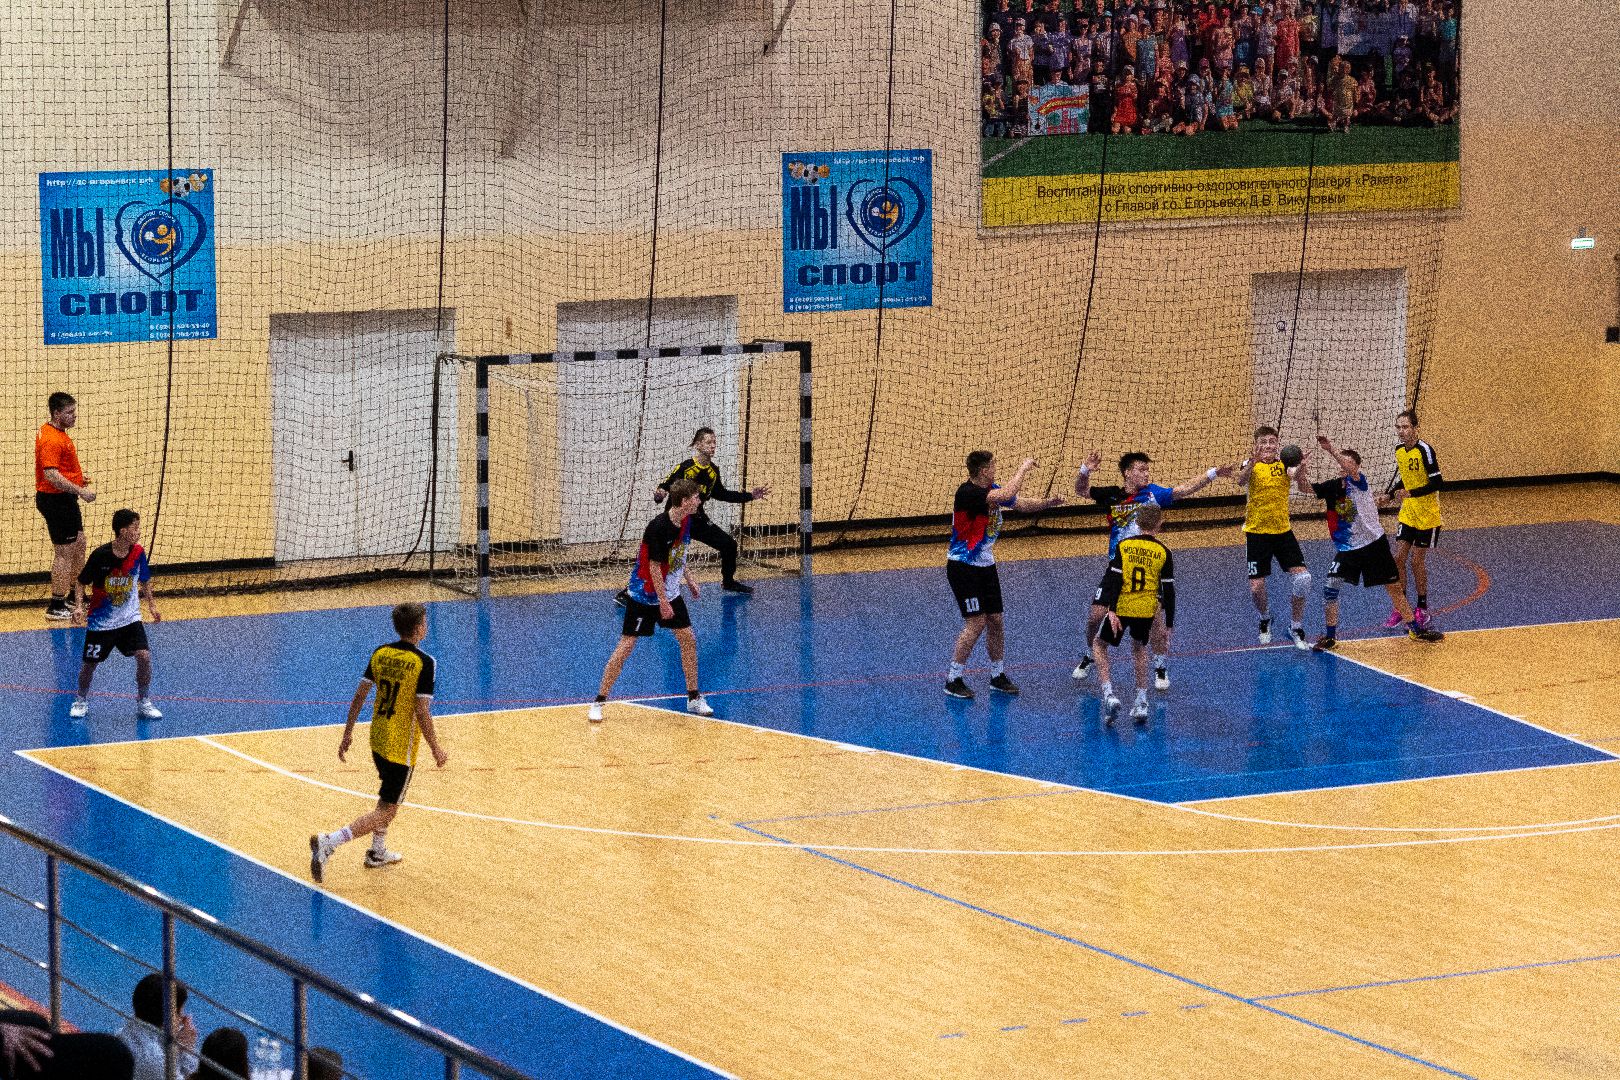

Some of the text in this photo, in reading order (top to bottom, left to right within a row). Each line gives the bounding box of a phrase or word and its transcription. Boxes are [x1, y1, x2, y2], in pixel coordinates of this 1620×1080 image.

[1310, 175, 1351, 189] лагеря
[1355, 173, 1409, 186] «Ракета»
[1104, 202, 1112, 212] с
[1115, 198, 1159, 212] Главой
[1185, 196, 1247, 210] Егорьевск
[1278, 193, 1346, 206] Викуловым
[790, 185, 838, 250] МЫ
[51, 207, 106, 278] МЫ
[798, 261, 922, 286] спорт
[59, 289, 204, 317] спорт
[1408, 457, 1420, 471] 23
[964, 597, 980, 613] 10
[86, 643, 101, 659] 22
